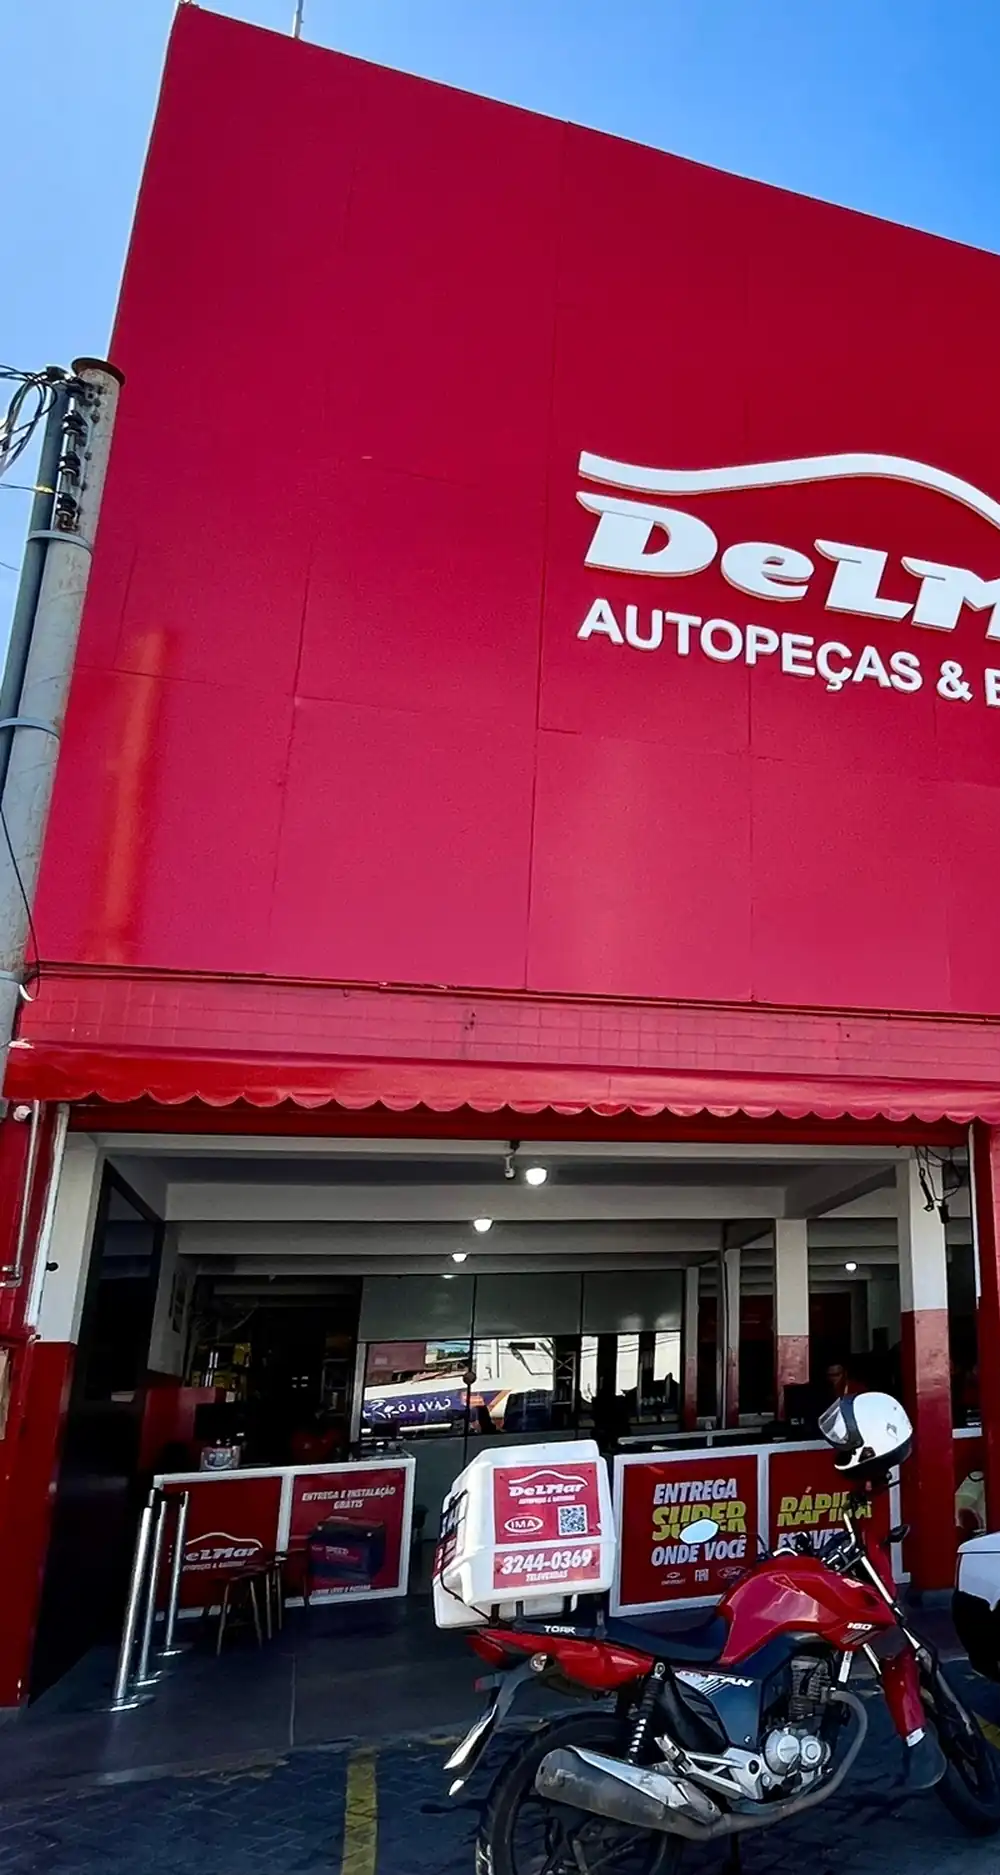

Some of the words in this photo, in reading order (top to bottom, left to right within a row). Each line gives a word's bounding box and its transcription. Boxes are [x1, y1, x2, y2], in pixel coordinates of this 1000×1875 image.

[576, 598, 923, 692] AUTOPEÇAS
[937, 660, 973, 703] &
[302, 1490, 338, 1501] ENTREGA
[340, 1489, 346, 1499] E
[347, 1484, 396, 1498] INSTALAÇÃO
[653, 1478, 737, 1505] ENTREGA
[511, 1519, 536, 1529] IMA
[169, 1546, 259, 1562] eLMar
[651, 1545, 700, 1567] ONDE
[704, 1535, 747, 1561] VOCÊ
[501, 1548, 593, 1575] 3244-0369
[544, 1624, 576, 1635] TORK
[847, 1622, 872, 1631] 160
